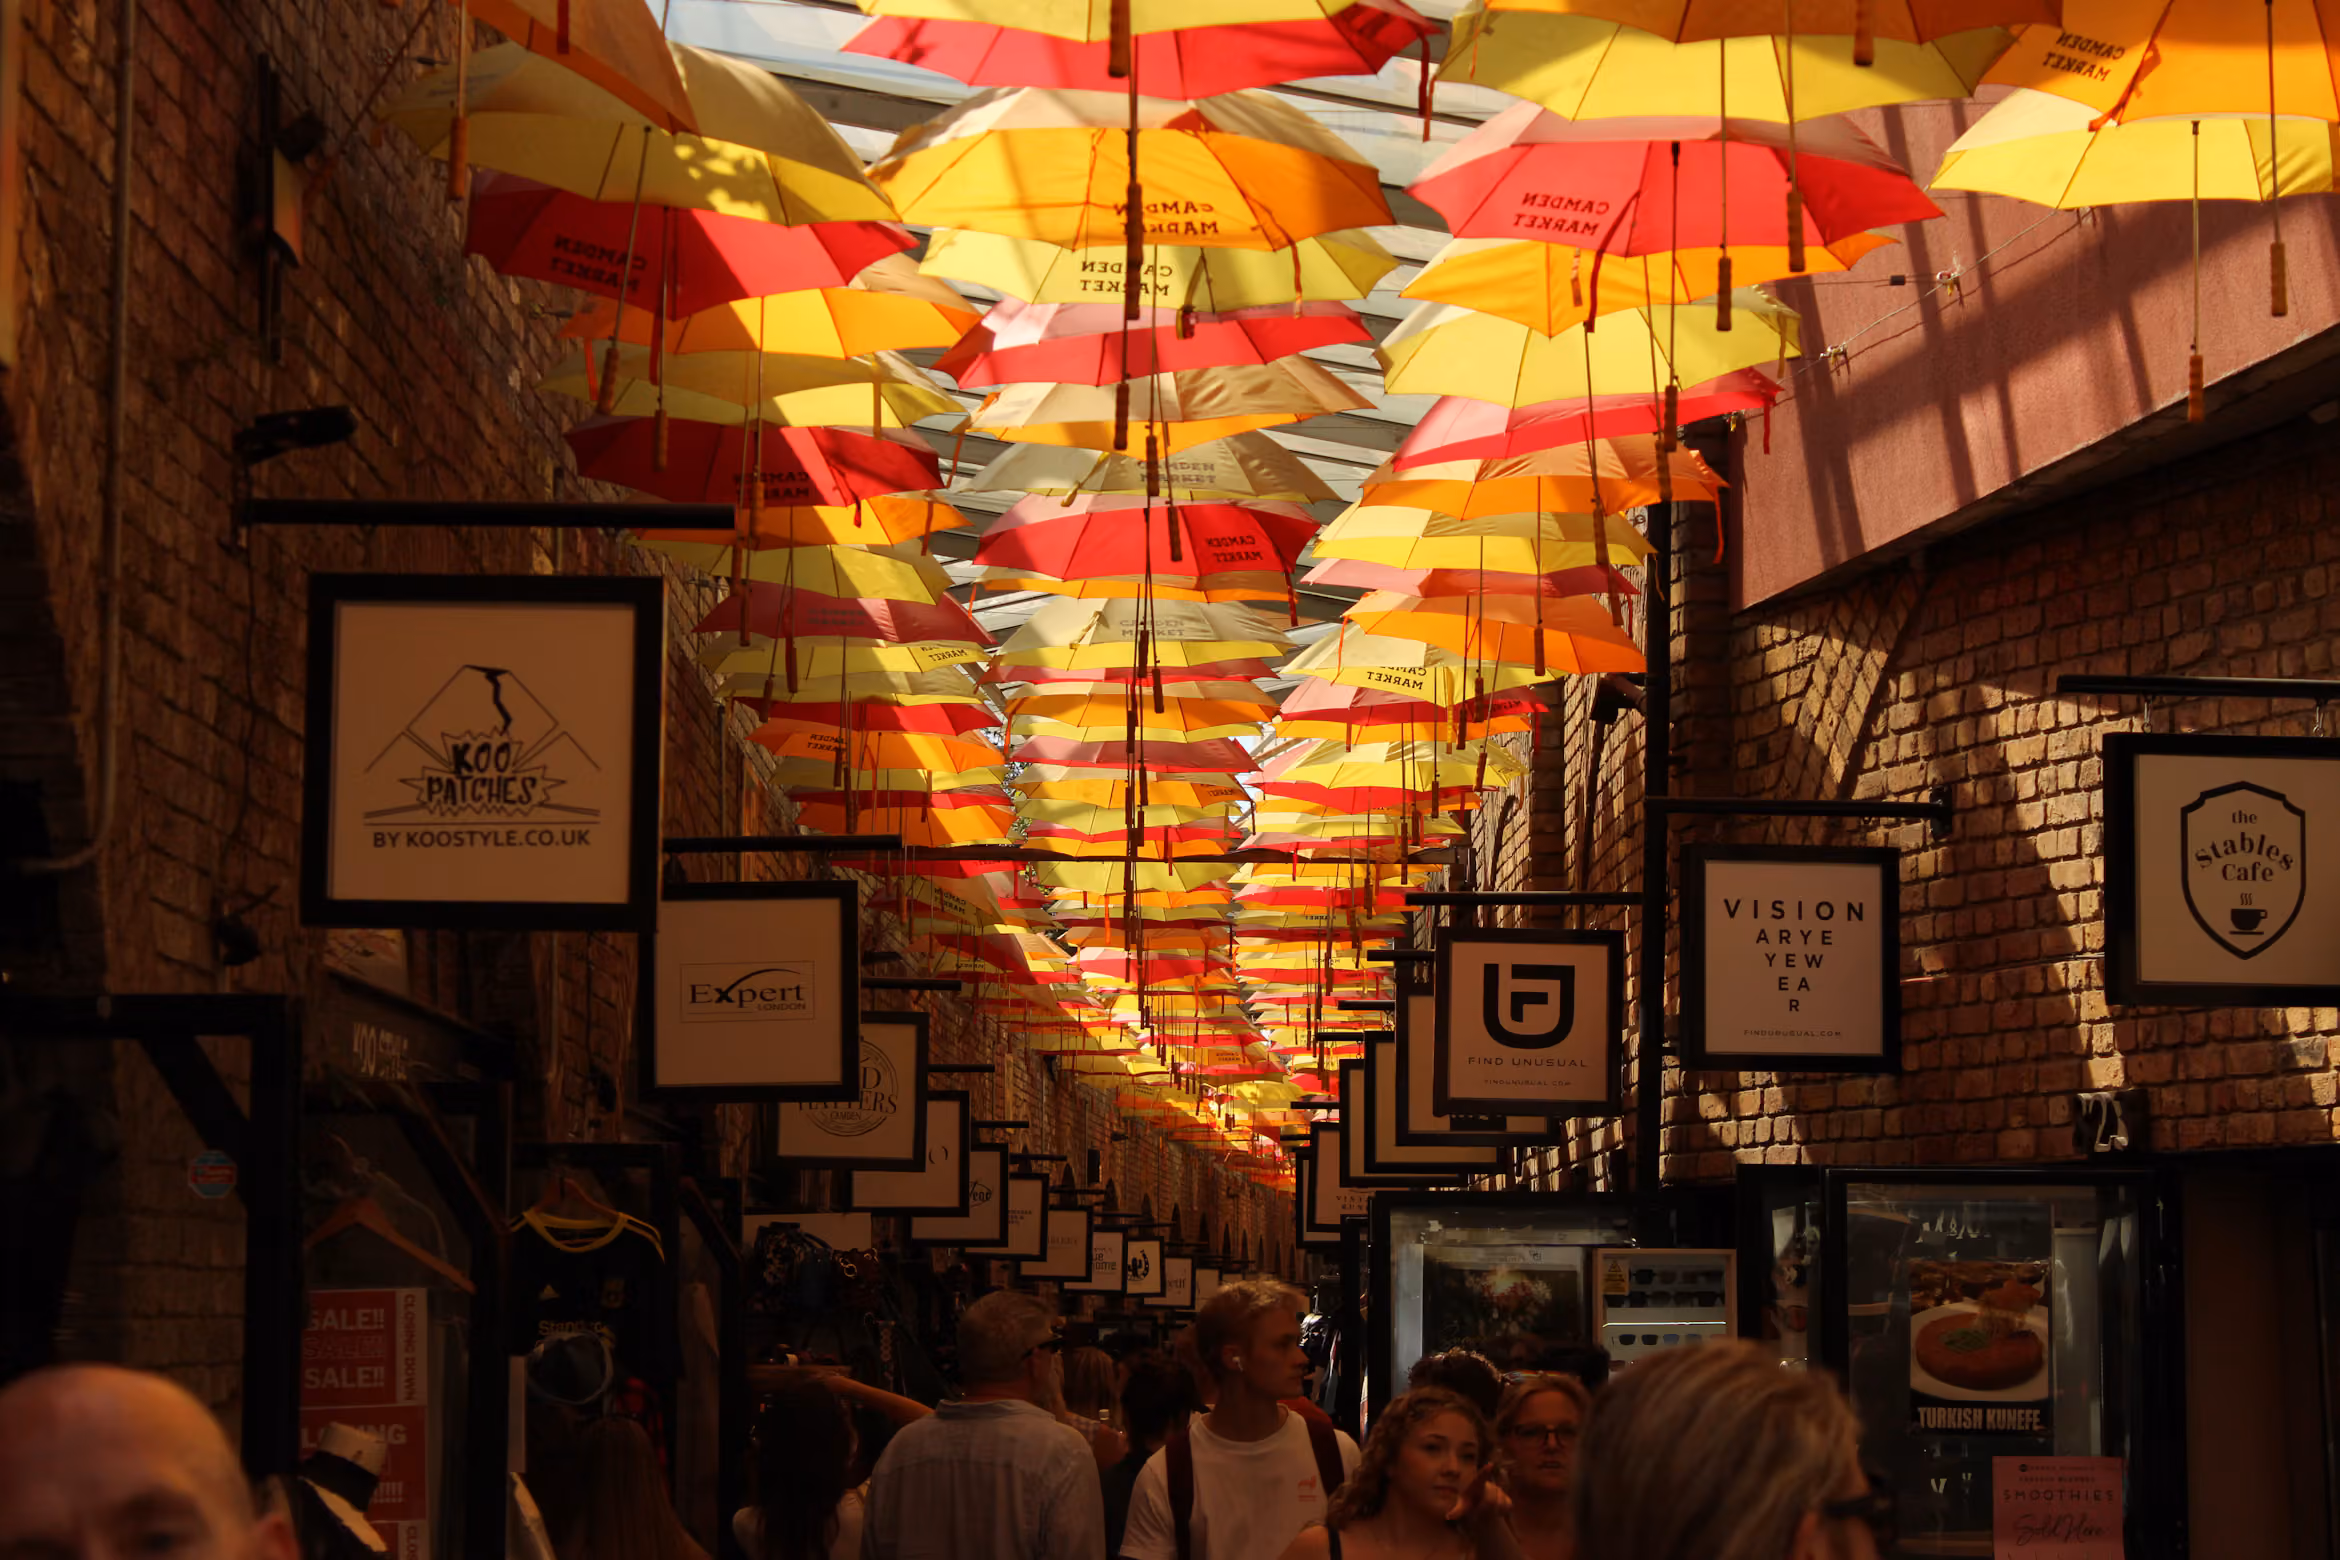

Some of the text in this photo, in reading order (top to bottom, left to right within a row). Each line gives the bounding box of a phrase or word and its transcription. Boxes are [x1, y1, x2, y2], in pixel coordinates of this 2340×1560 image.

[452, 742, 512, 775] KOO
[427, 773, 537, 805] PATCHES
[2231, 810, 2258, 824] the
[373, 830, 591, 849] BY KOOSTYLE.CO.UK
[2194, 831, 2295, 871] Stables
[2221, 861, 2274, 883] Cafe
[1724, 898, 1865, 921] VISION
[1756, 929, 1833, 946] ARYE
[1765, 953, 1824, 969] YEW
[690, 980, 805, 1010] Expert
[1778, 976, 1811, 992] EA
[757, 1002, 807, 1013] LONDON
[1788, 999, 1800, 1012] R
[1467, 1056, 1588, 1069] FIND UNUSUAL
[309, 1307, 386, 1332] SALE!!
[403, 1293, 418, 1401] CLOSING DOWN
[303, 1365, 386, 1390] SALE!!
[1918, 1407, 2042, 1431] TURKISH KUNEFE
[2003, 1489, 2114, 1503] SMOOTHIES
[2013, 1513, 2106, 1547] Sold Here
